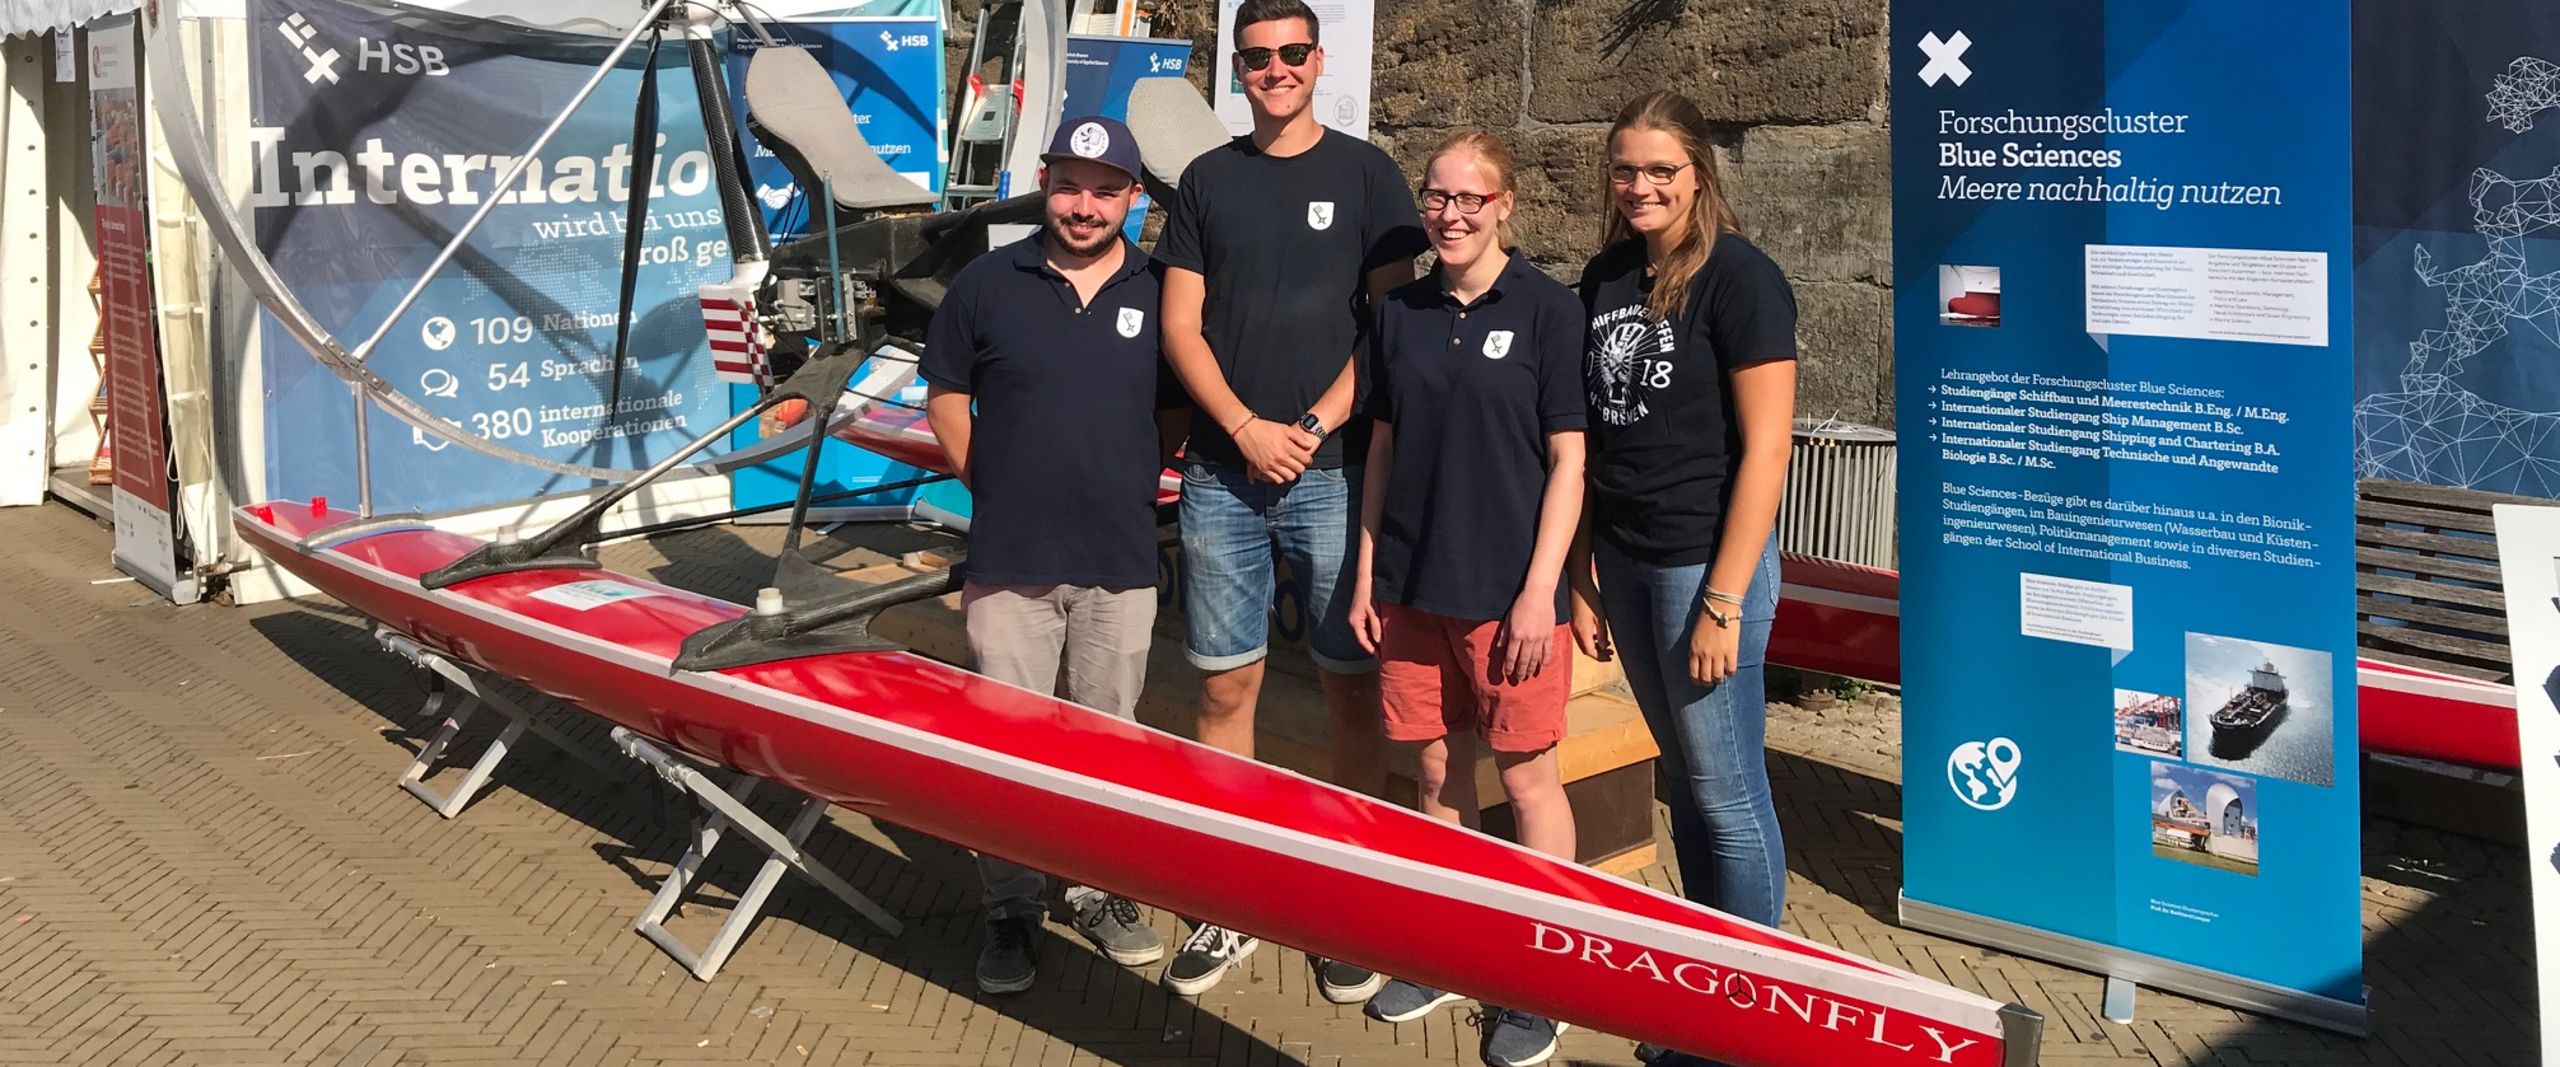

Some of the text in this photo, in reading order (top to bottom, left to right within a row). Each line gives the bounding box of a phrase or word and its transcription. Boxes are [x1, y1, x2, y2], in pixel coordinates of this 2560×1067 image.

[358, 37, 449, 76] HSB
[901, 35, 929, 47] HSB
[1162, 58, 1182, 70] HSB
[1938, 108, 2188, 141] Forschungscluster
[1939, 142, 2122, 168] Blue Sciences
[1938, 176, 2282, 210] Meere nachhaltig nutzen
[533, 208, 722, 240] wird bi uns
[621, 236, 689, 272] roß
[469, 316, 533, 345] 109
[488, 362, 531, 391] 54
[540, 354, 640, 381] Sprachn
[1941, 368, 2225, 399] Lehrangebot der Forschungscluster Blue Sciences:
[1941, 385, 2290, 424] Studiengänge Schiffbau und Meerestechnik B.Eng. / M.Eng.
[1941, 400, 2244, 435] Internationaler Studiengang Ship Management B.Sc.
[471, 407, 533, 440] 380
[541, 414, 687, 448] Kooperationen
[1941, 417, 2280, 456] Internationaler Studiengang Shipping and Chartering B.A.
[1941, 433, 2279, 474] Internationaler Studiengang Technische und Angewandte
[1942, 449, 1986, 464] Biologie
[1988, 453, 2016, 466] B.Sc.
[2024, 456, 2056, 469] M.Sc.
[1942, 482, 1966, 495] Blue
[2065, 495, 2087, 508] gibt
[2090, 500, 2102, 509] es
[2104, 498, 2151, 515] darüber
[2153, 503, 2195, 519] hinaus
[2197, 511, 2219, 521] u.a.
[2220, 511, 2234, 523] in
[2236, 513, 2260, 526] den
[2262, 515, 2312, 532] Bionik-
[1942, 499, 2319, 550] Studiengängen, im Bauingenieurwesen (Wasserbau und Küsten-
[1943, 514, 2321, 568] ingenieurwesen), Politikmanagement sowie in diversen Studien-
[1943, 532, 2192, 570] gängen der School of International Business.
[1525, 922, 1981, 1064] DRAGONFLY
